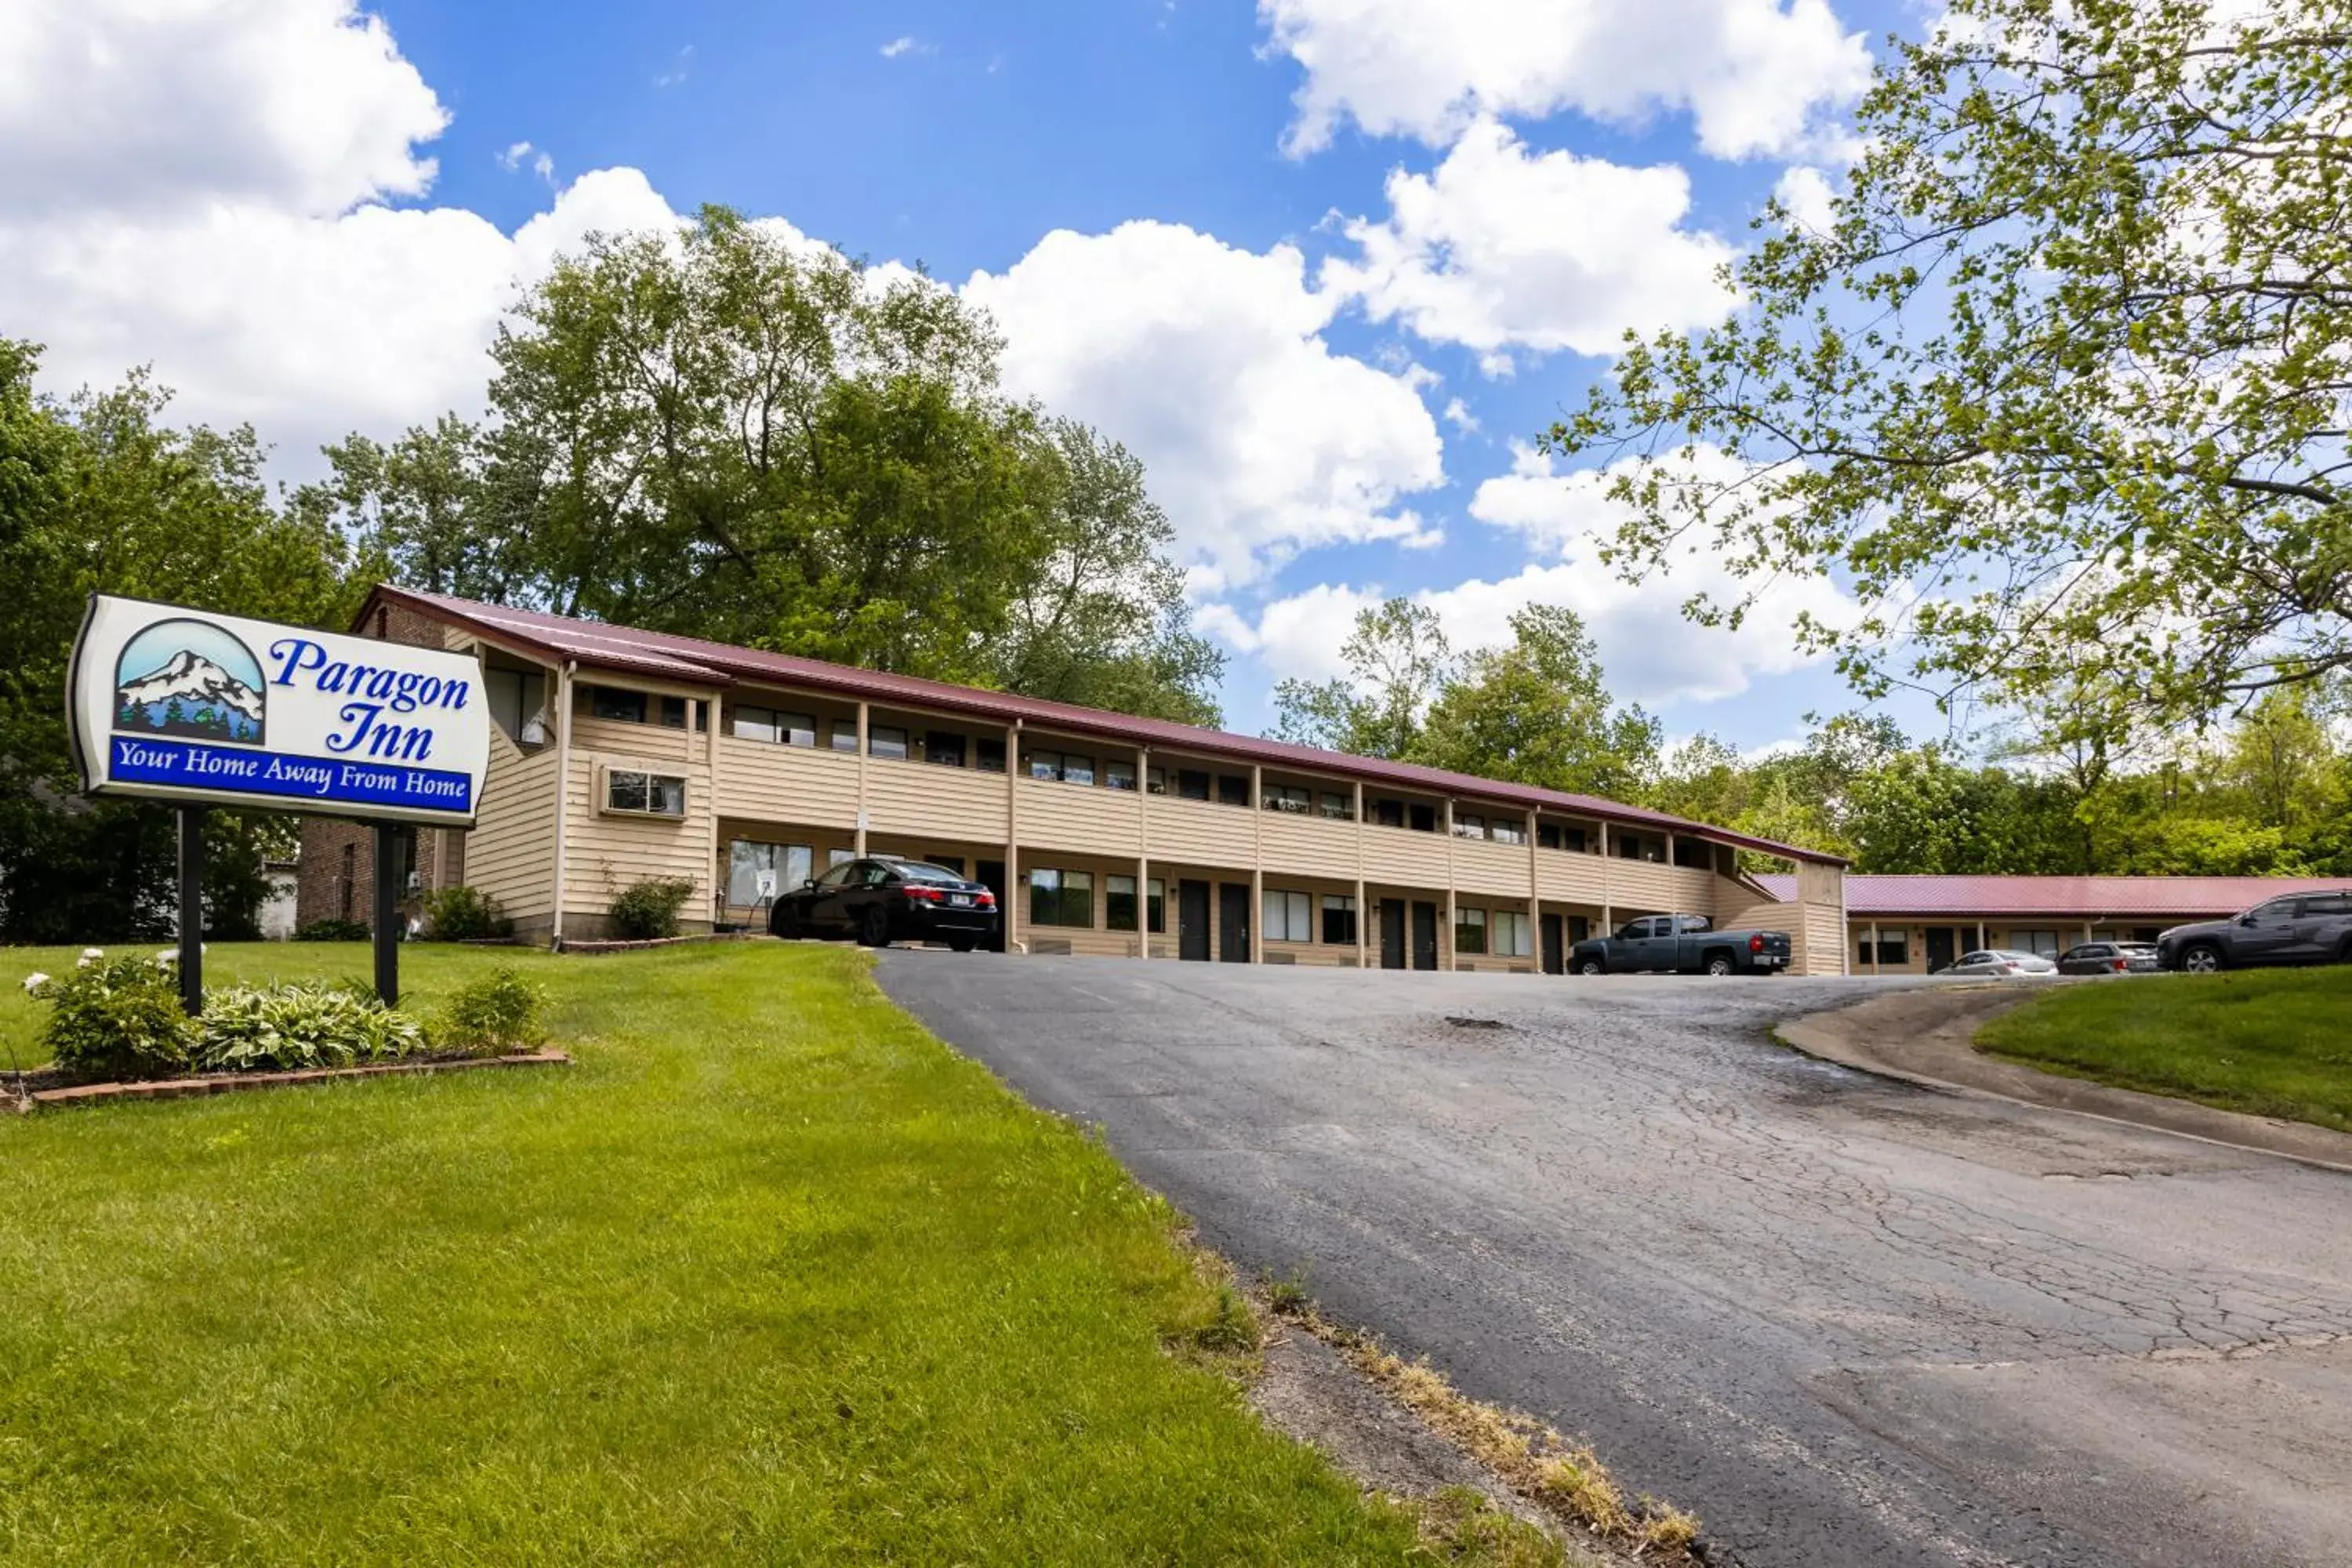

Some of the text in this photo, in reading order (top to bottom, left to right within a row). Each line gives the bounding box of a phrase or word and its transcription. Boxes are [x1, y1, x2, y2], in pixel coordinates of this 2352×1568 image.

[270, 639, 469, 713] Paragon
[325, 702, 434, 760] Inn
[118, 742, 466, 798] Your Home Away From Home
